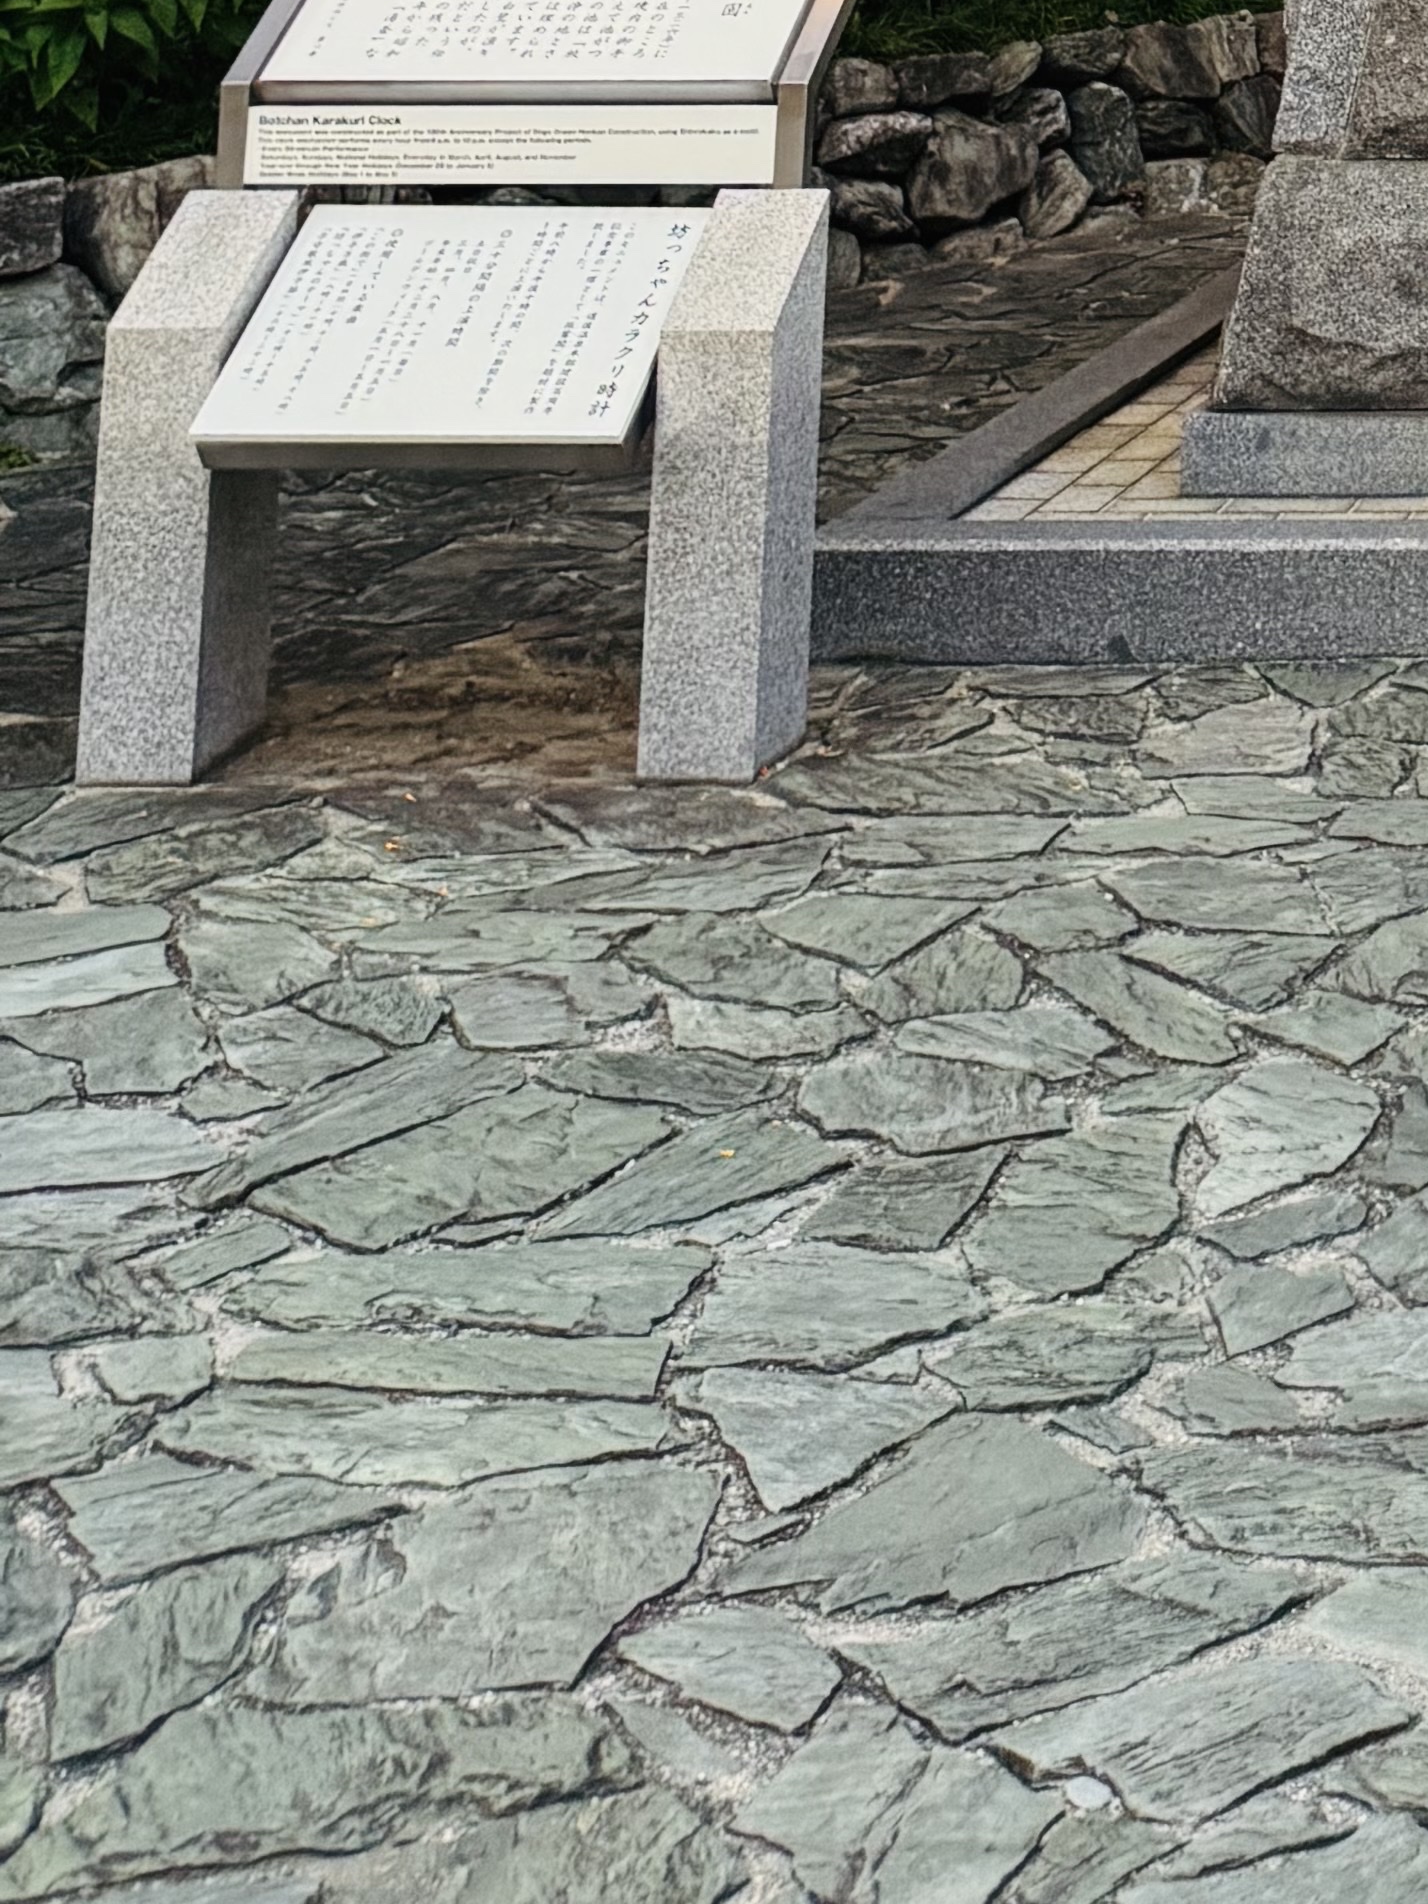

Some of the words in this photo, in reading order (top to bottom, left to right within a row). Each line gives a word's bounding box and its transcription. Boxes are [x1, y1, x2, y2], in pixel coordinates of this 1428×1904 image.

[258, 115, 309, 125] Botchan
[368, 115, 402, 126] Clock
[588, 224, 691, 418] 坊っちゃんカラクリ時計
